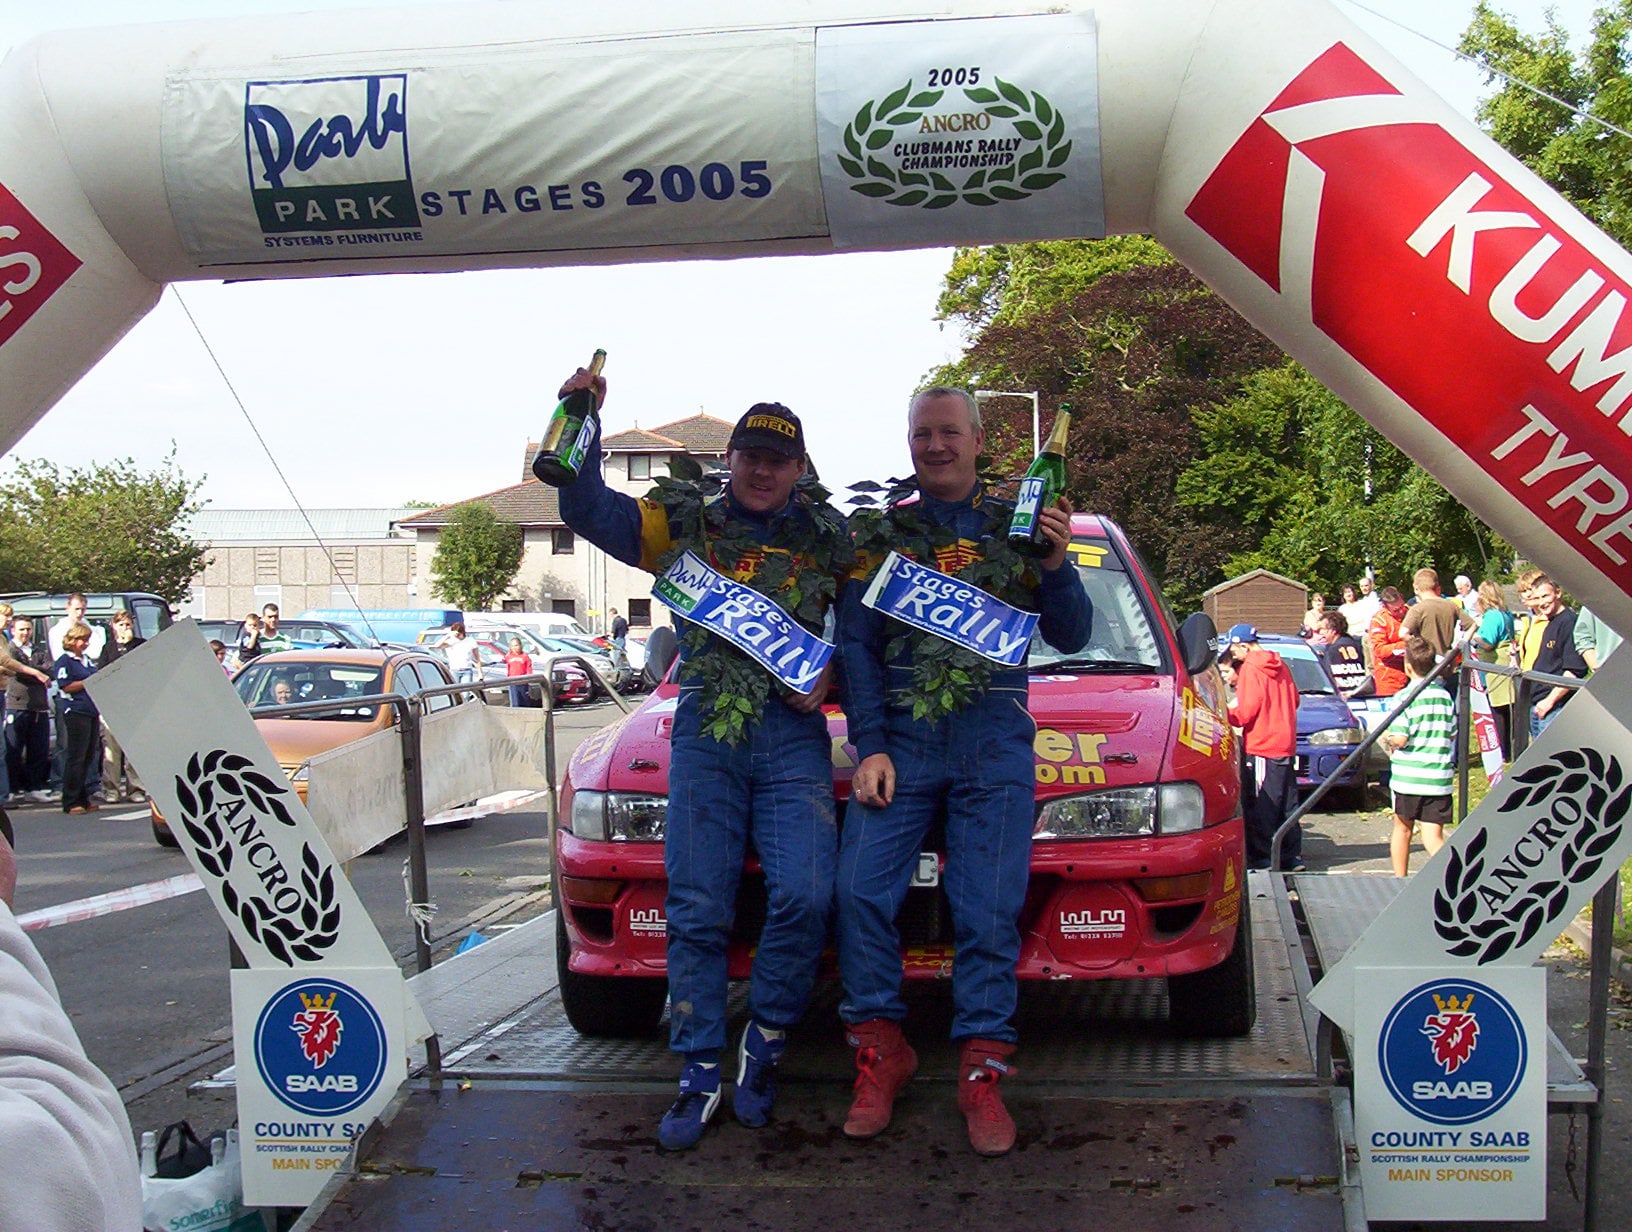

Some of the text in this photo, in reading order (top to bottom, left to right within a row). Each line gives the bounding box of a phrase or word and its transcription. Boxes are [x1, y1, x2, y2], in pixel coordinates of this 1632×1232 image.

[928, 67, 981, 87] 2005
[918, 112, 991, 134] ANCRO
[893, 137, 1022, 157] CLUBMANS RALLY
[901, 151, 1015, 171] CHAMPIONSHIP
[420, 160, 772, 217] STAGES 2005
[274, 195, 395, 222] PARK
[264, 231, 423, 248] SYSTEMS FURNITURE
[0, 225, 42, 296] S
[1406, 171, 1632, 437] KUM
[660, 582, 690, 607] PARK
[896, 561, 986, 609] Stages
[711, 580, 793, 634] Stages
[894, 586, 1027, 659] Rally
[705, 599, 824, 685] Rally
[1033, 727, 1108, 764] er
[1034, 763, 1107, 785] om
[215, 798, 302, 915] ANCRO
[1477, 796, 1582, 916] ANCRO
[286, 1074, 359, 1093] SAAB
[1412, 1081, 1493, 1100] SAAB
[254, 1122, 366, 1138] COUNTY SA
[1371, 1131, 1531, 1148] COUNTY SAAB
[256, 1144, 299, 1153] SCOTTISH
[300, 1144, 327, 1153] RALLY
[1371, 1154, 1531, 1164] SCOTTISH RALLY CHAMPIONSHIP
[272, 1158, 343, 1171] MAIN SPO
[1388, 1168, 1514, 1183] MAIN SPONSOR
